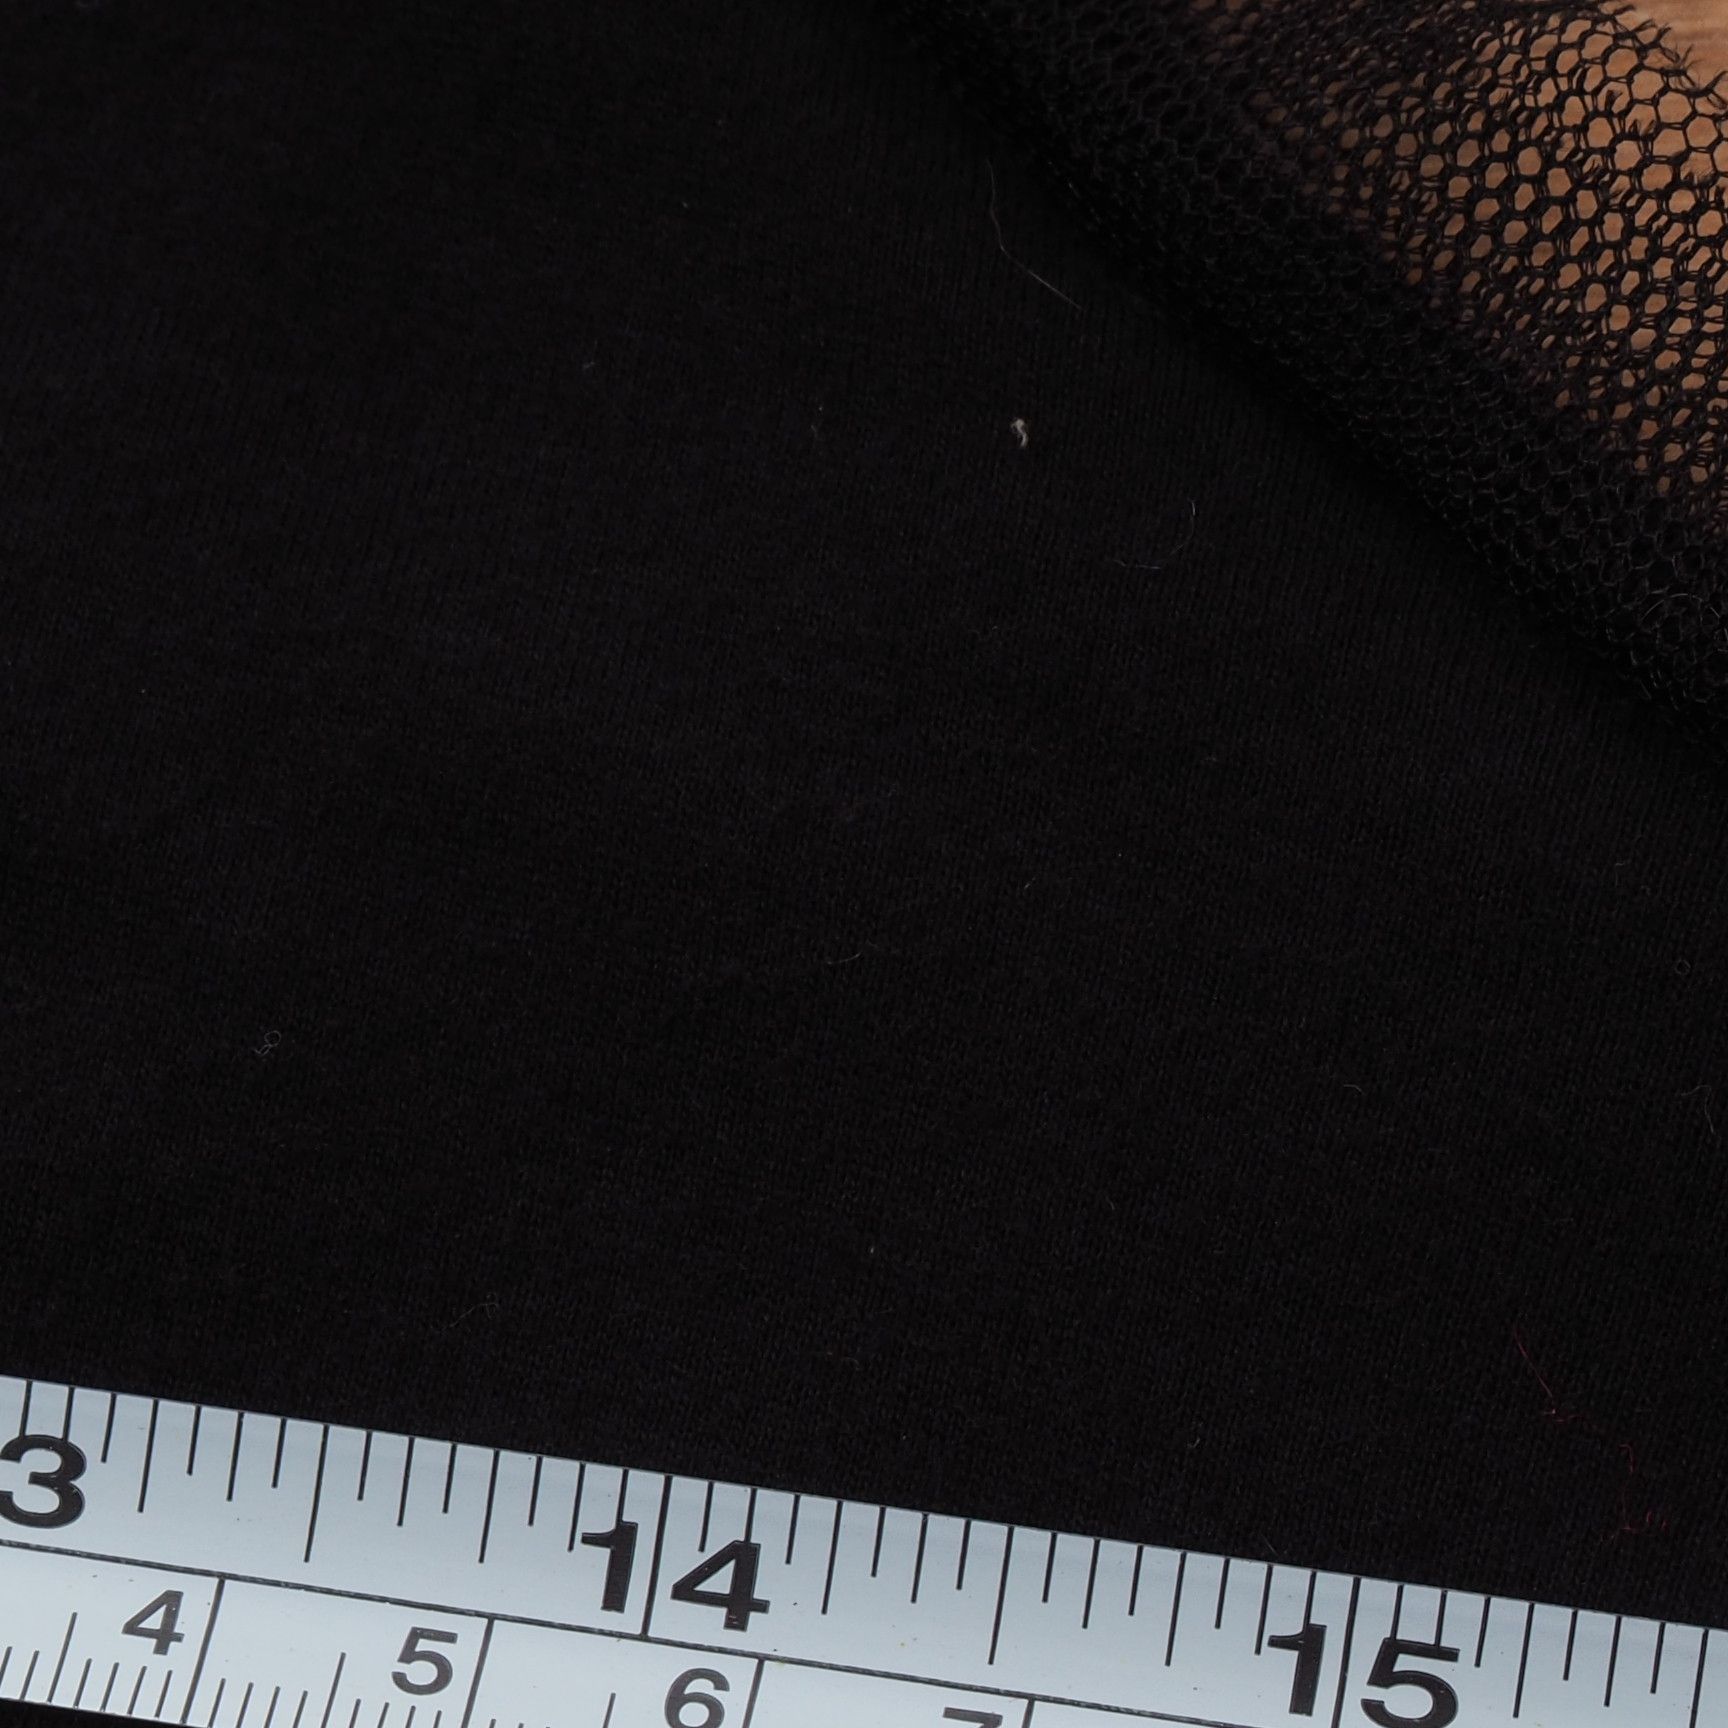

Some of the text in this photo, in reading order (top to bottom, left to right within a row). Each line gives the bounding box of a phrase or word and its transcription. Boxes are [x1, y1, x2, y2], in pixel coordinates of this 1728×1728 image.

[580, 1520, 770, 1632] 14
[122, 1589, 186, 1657] 4
[390, 1626, 459, 1697] 5
